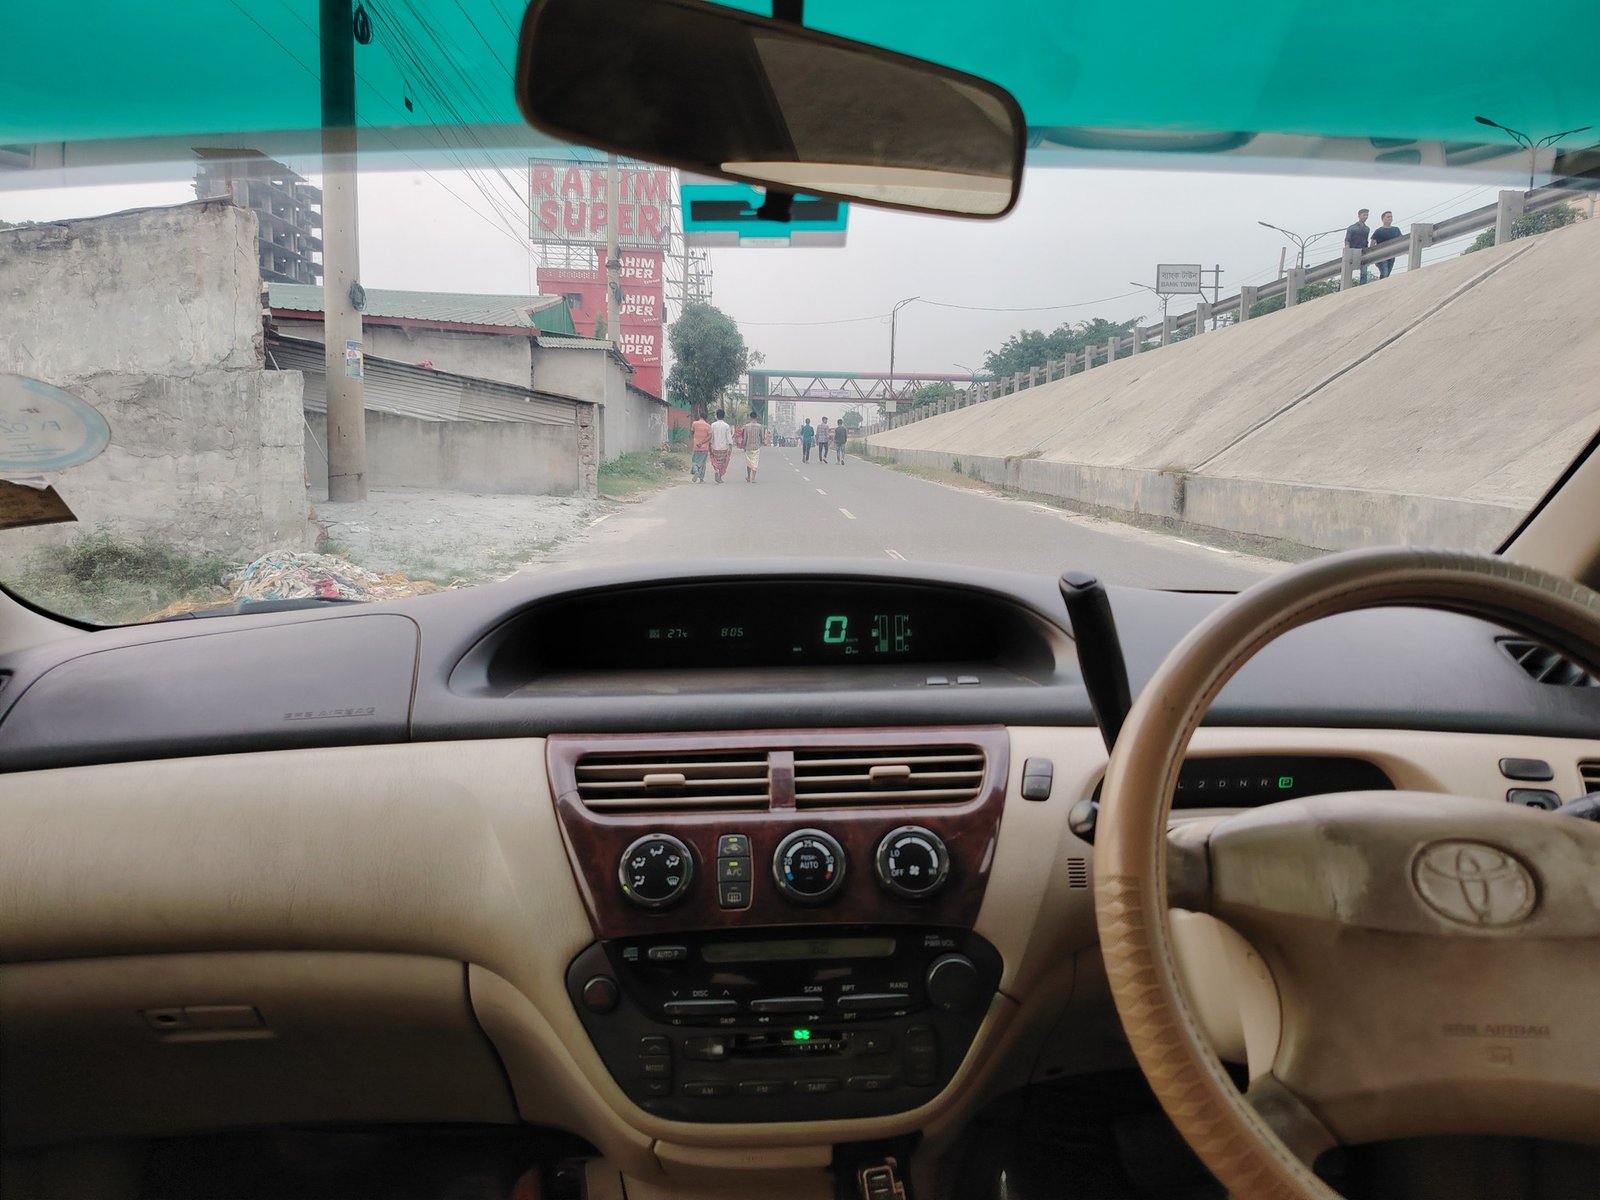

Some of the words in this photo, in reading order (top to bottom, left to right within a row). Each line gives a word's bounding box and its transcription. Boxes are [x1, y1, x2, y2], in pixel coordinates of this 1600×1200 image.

[532, 164, 668, 201] RAHIM
[538, 199, 665, 241] SUPER
[606, 268, 653, 279] UPER
[823, 615, 848, 643] 0
[1198, 780, 1206, 788] 2
[1218, 780, 1226, 788] D
[1239, 779, 1248, 787] N
[1260, 778, 1269, 787] R
[803, 839, 812, 848] 25
[890, 849, 900, 857] LO
[783, 857, 793, 865] 20
[825, 855, 835, 864] 30
[800, 860, 819, 869] AUTO
[726, 868, 742, 876] A/C
[891, 868, 904, 877] OFF
[803, 985, 823, 993] SCAN
[842, 984, 856, 992] RPT
[702, 1087, 714, 1095] AM
